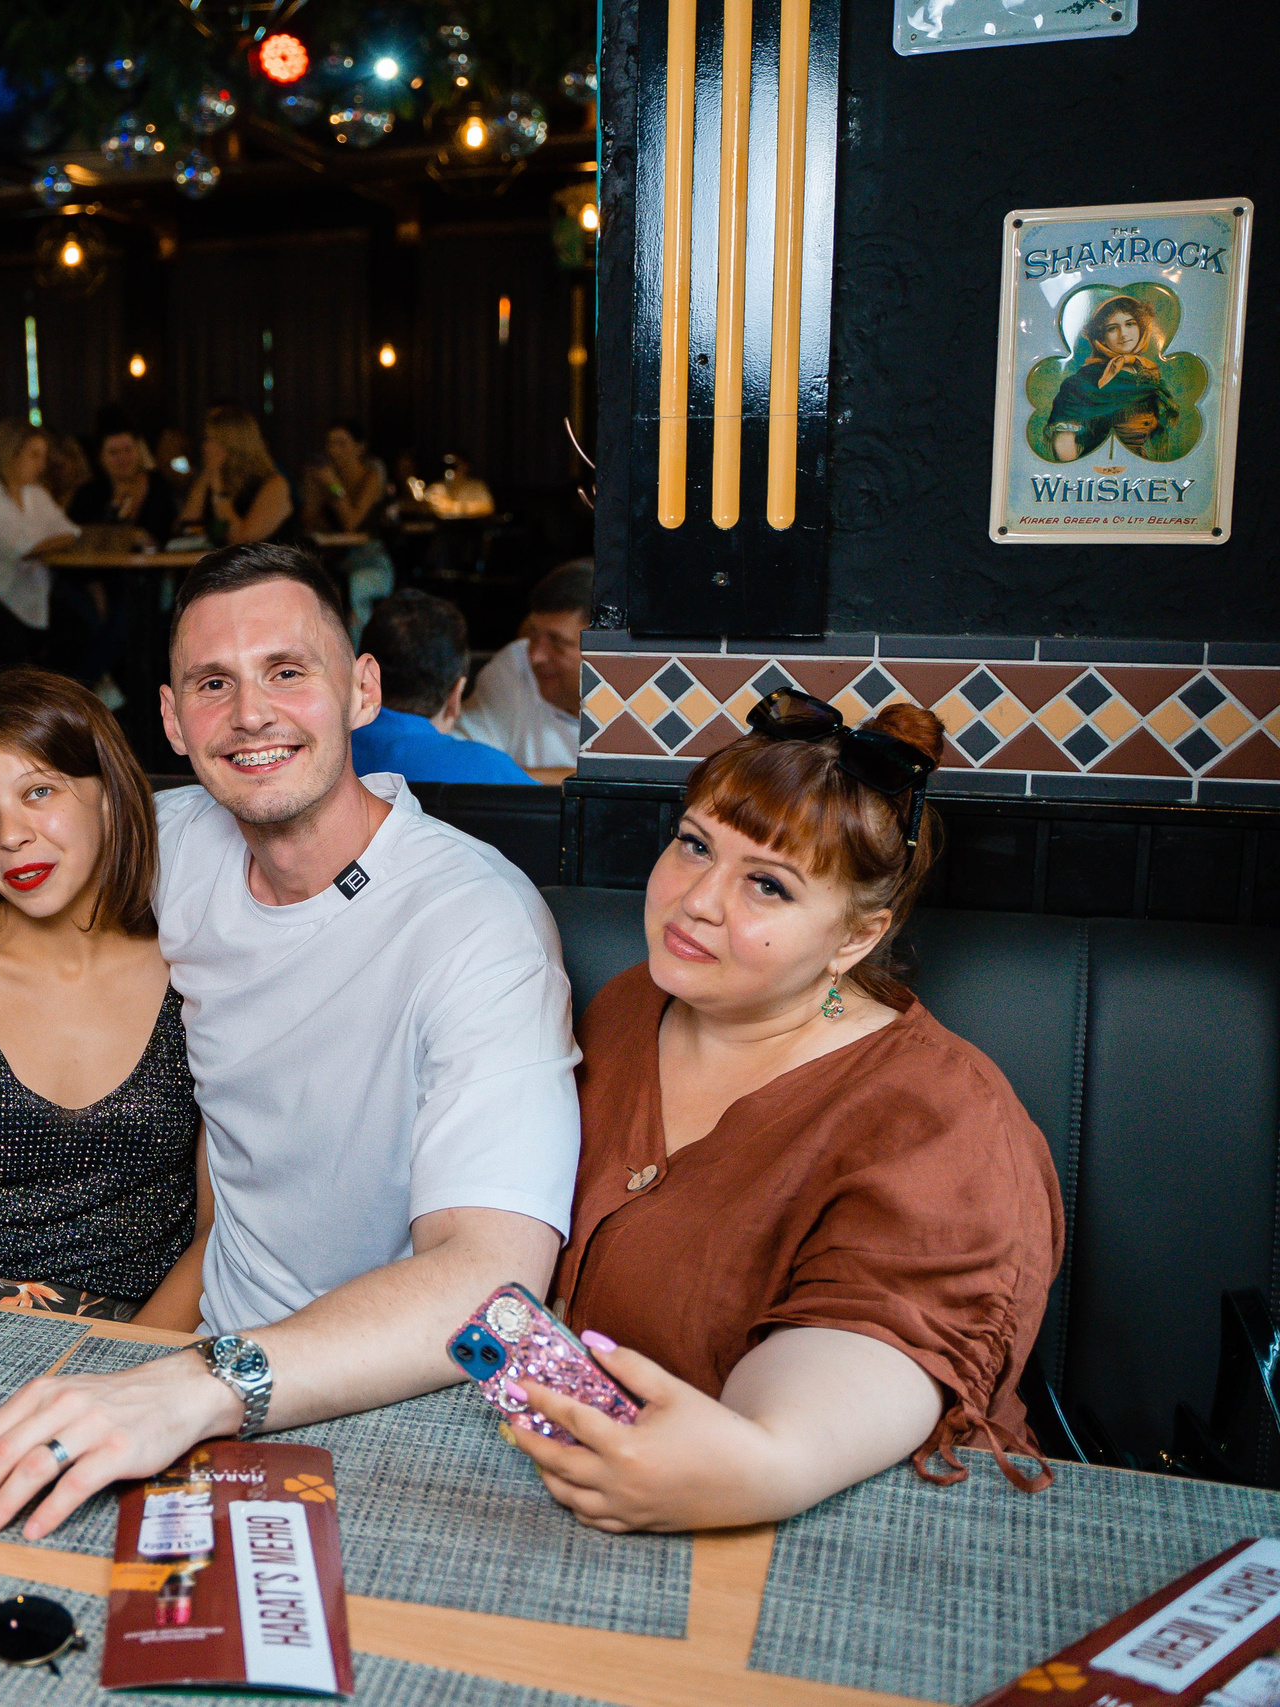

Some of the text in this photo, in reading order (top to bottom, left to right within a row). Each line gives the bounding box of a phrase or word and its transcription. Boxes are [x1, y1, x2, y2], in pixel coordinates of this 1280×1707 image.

[1025, 238, 1227, 280] SHAMROCK
[1030, 475, 1196, 503] WHISKEY
[1020, 515, 1060, 525] KIRKER
[1063, 515, 1101, 525] GREER
